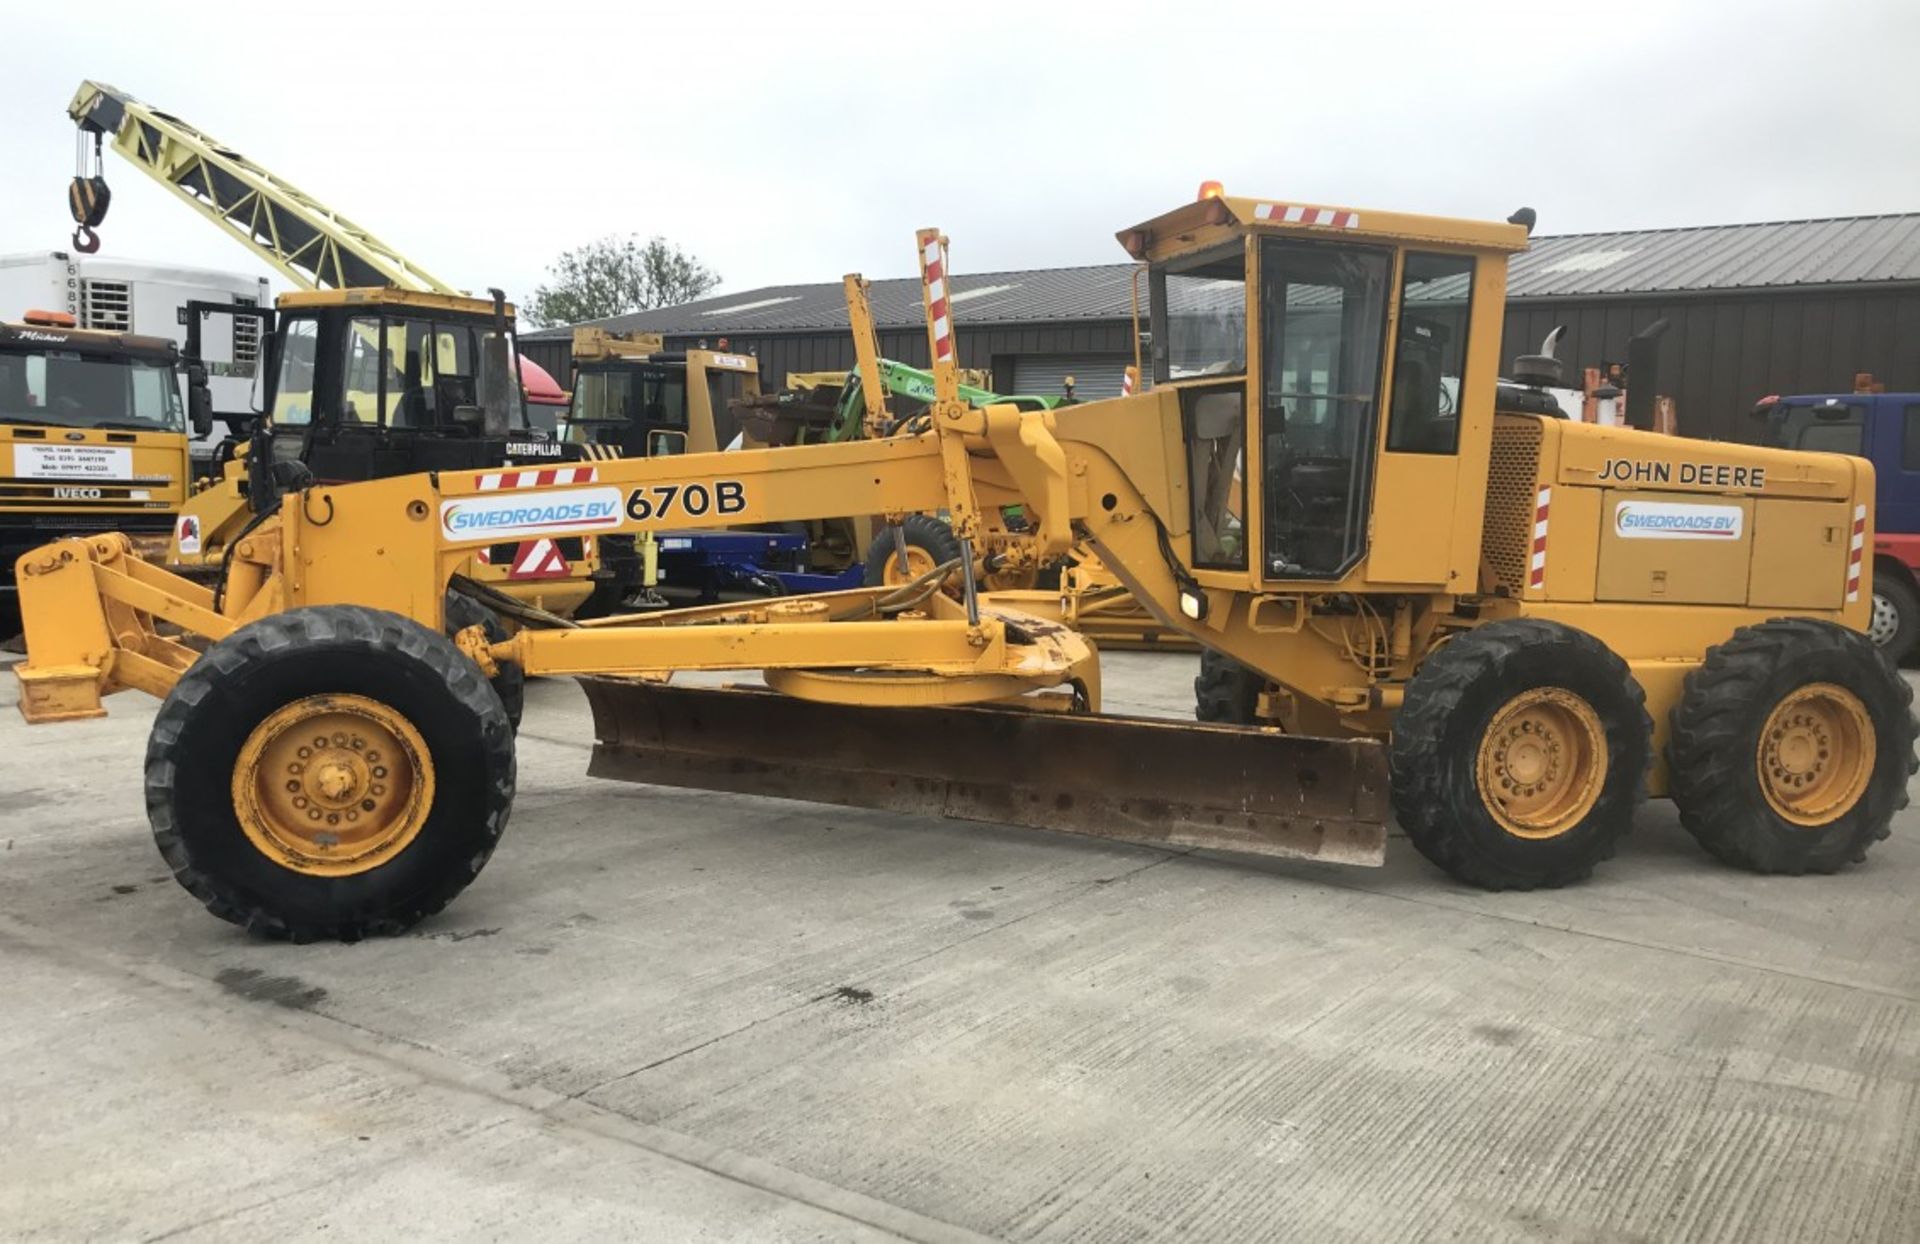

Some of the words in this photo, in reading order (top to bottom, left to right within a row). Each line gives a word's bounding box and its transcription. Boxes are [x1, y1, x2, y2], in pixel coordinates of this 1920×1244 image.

[506, 442, 562, 457] CATERPILLAR
[1598, 459, 1671, 483] JOHN
[1679, 463, 1765, 488] DEERE
[53, 487, 101, 499] IVECO
[625, 480, 747, 521] 670B
[453, 504, 583, 529] SWEDROADS
[585, 501, 616, 518] BV
[1623, 513, 1713, 529] SWEDROADS
[1713, 516, 1736, 530] BV
